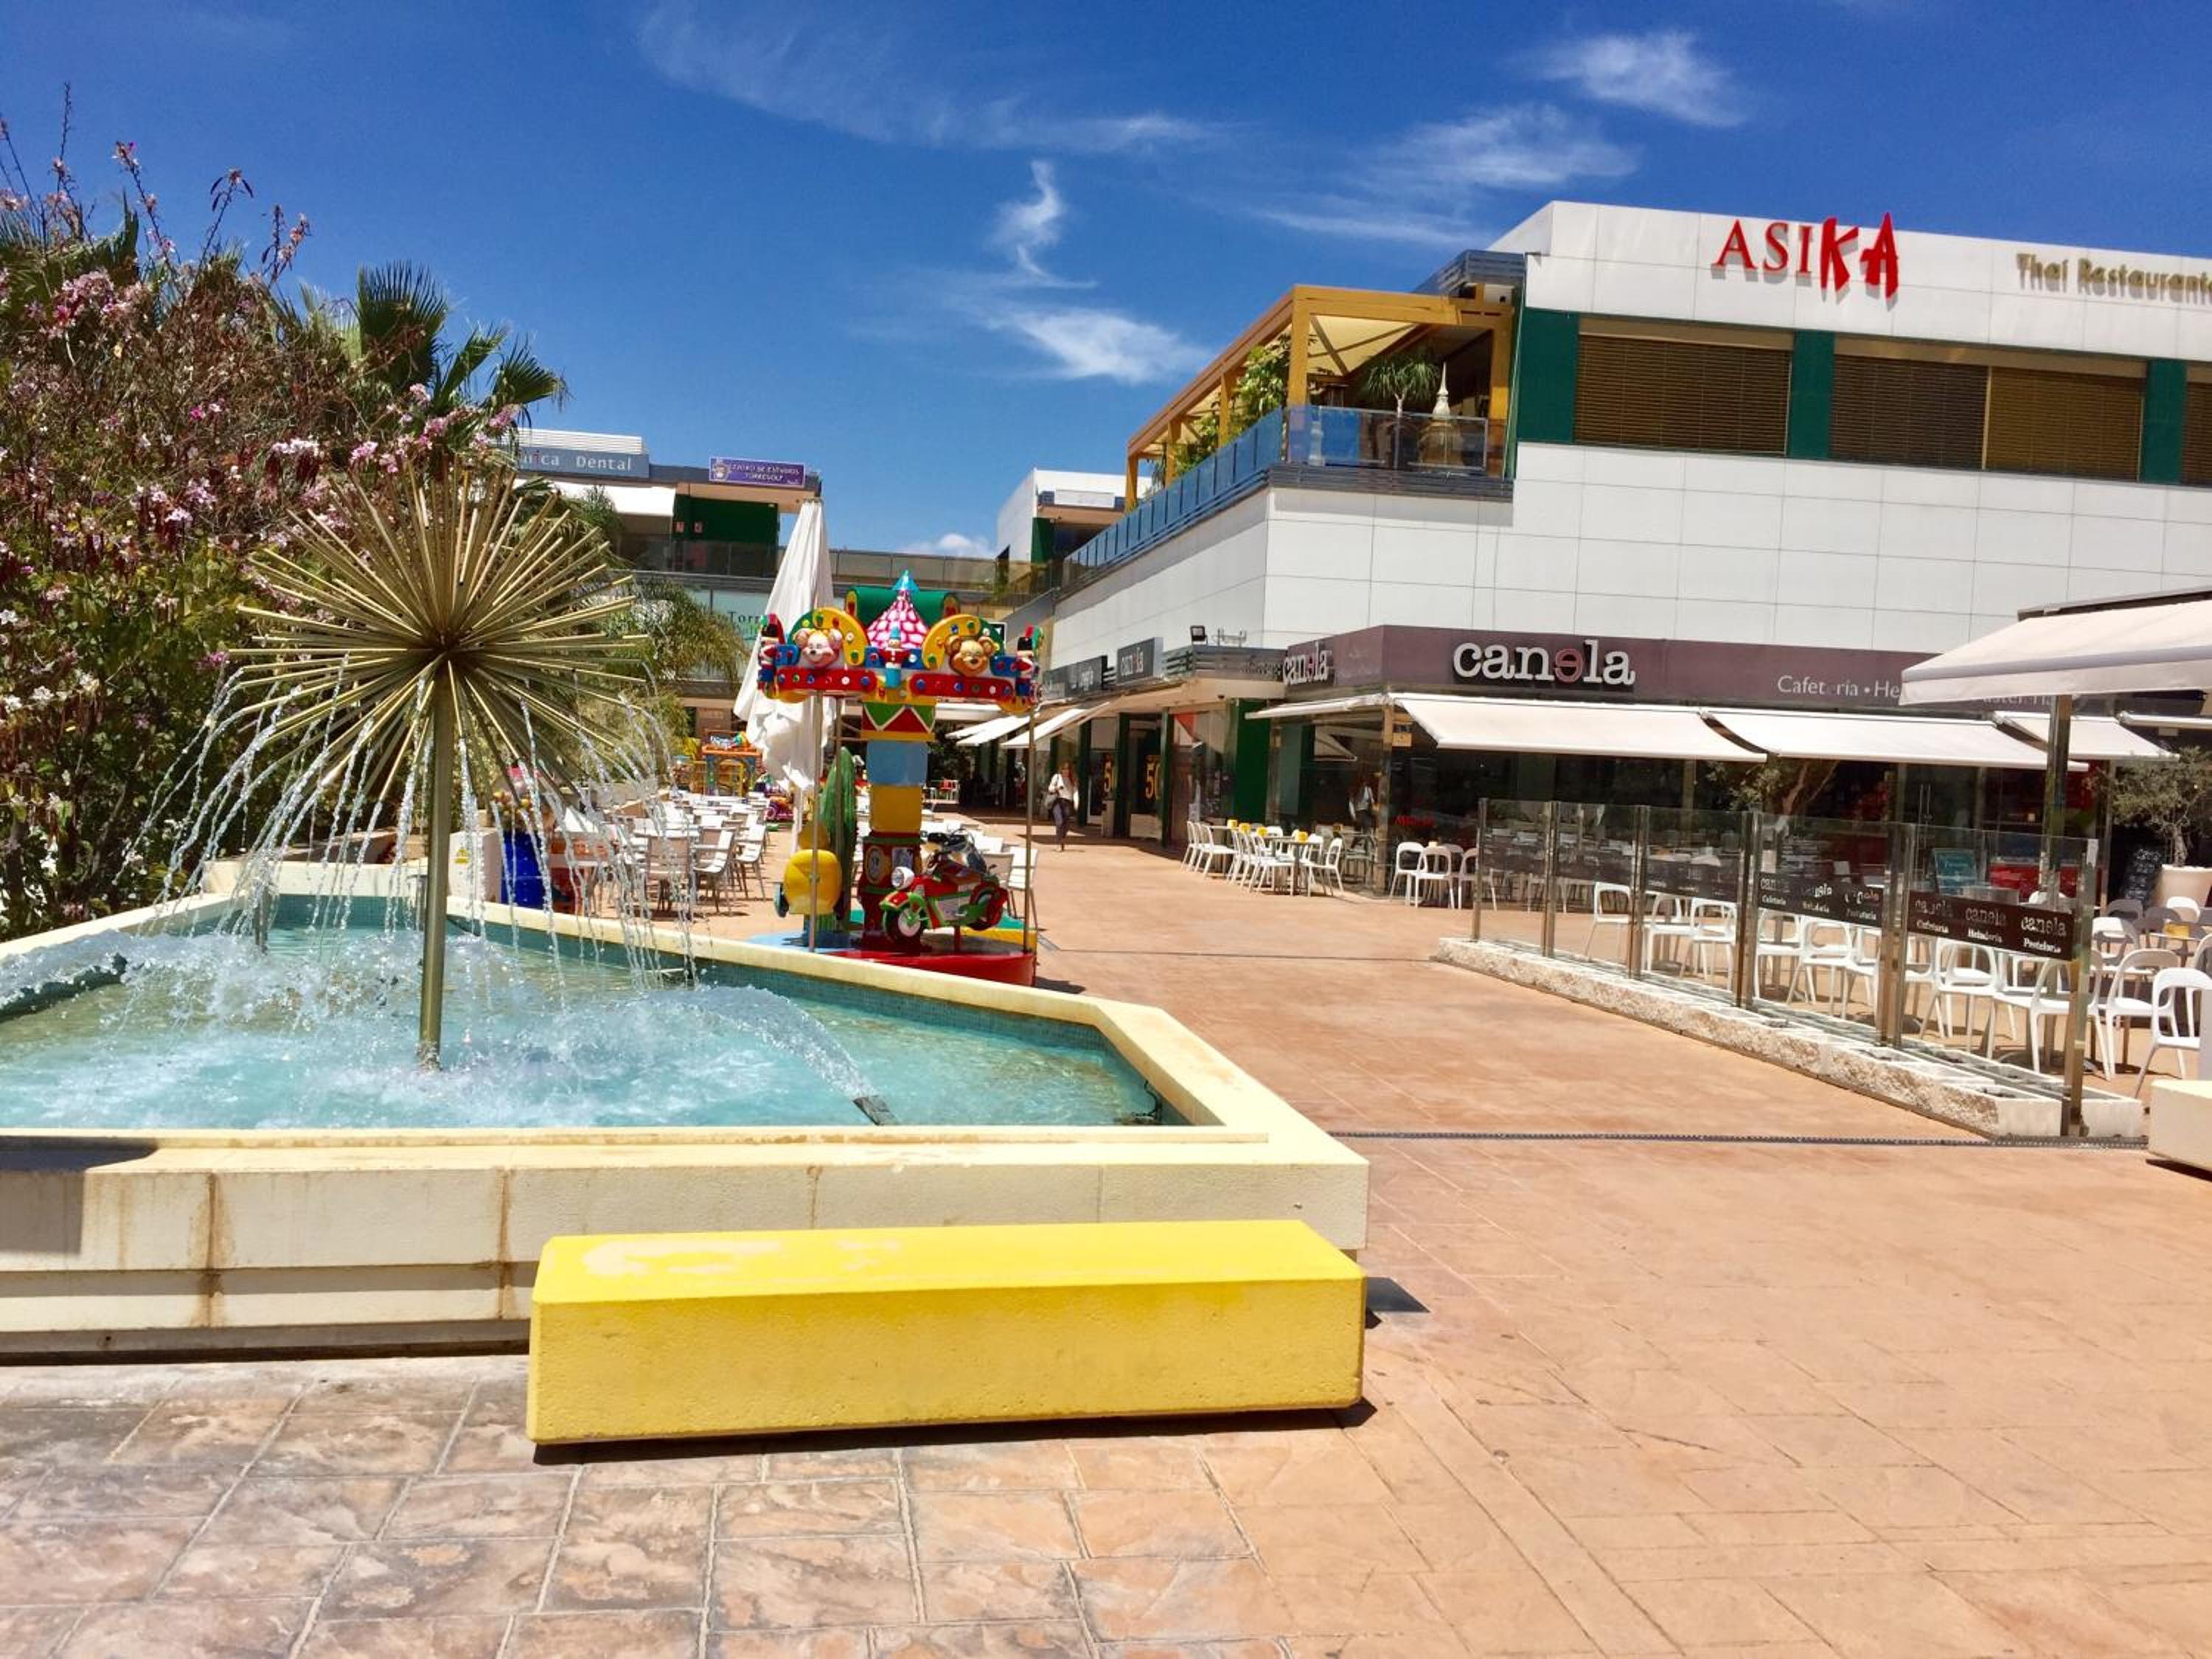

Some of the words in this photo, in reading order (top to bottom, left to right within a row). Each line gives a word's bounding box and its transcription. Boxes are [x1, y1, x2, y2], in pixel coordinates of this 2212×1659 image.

[1715, 212, 1899, 299] ASIKA
[2017, 253, 2068, 280] Thai
[2078, 258, 2211, 293] Restaurant
[576, 455, 631, 472] Dental
[727, 611, 760, 624] Torr
[1282, 641, 1329, 686] canela
[1453, 639, 1636, 686] canela
[1874, 680, 1900, 698] He
[2021, 917, 2066, 937] canela
